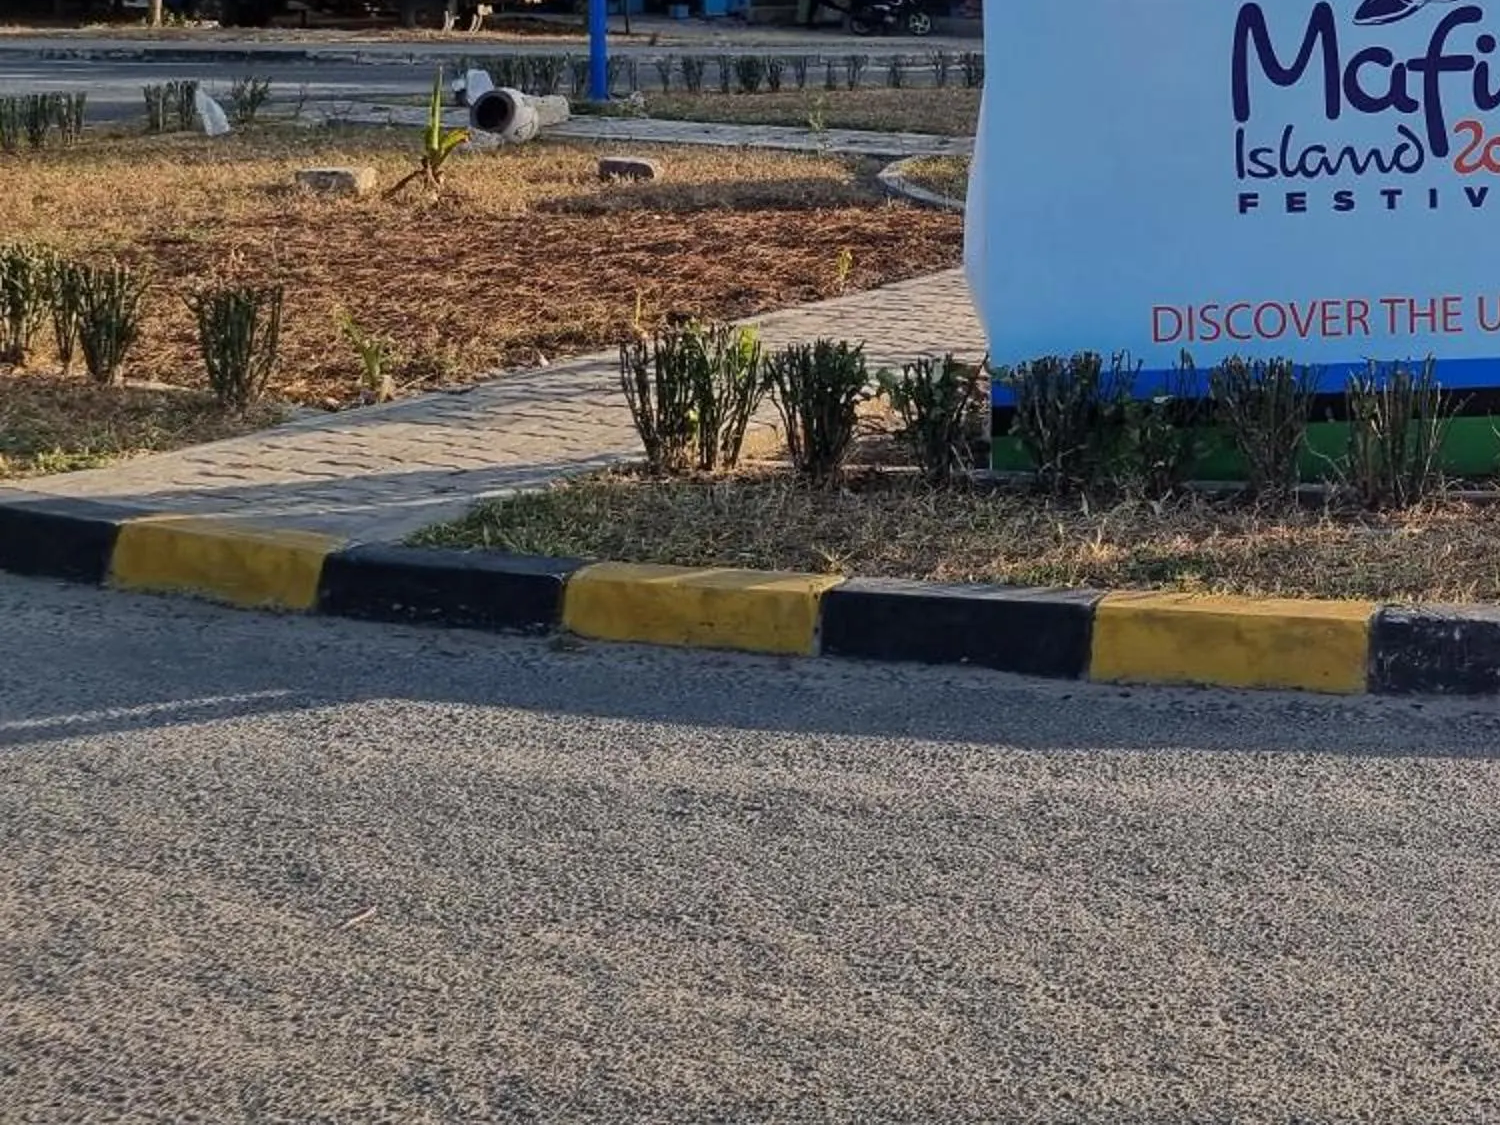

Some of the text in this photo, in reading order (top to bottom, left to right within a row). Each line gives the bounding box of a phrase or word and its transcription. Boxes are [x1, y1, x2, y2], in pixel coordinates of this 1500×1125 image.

[1235, 124, 1425, 180] Island
[1153, 299, 1370, 343] DISCOVER
[1381, 296, 1463, 334] THE
